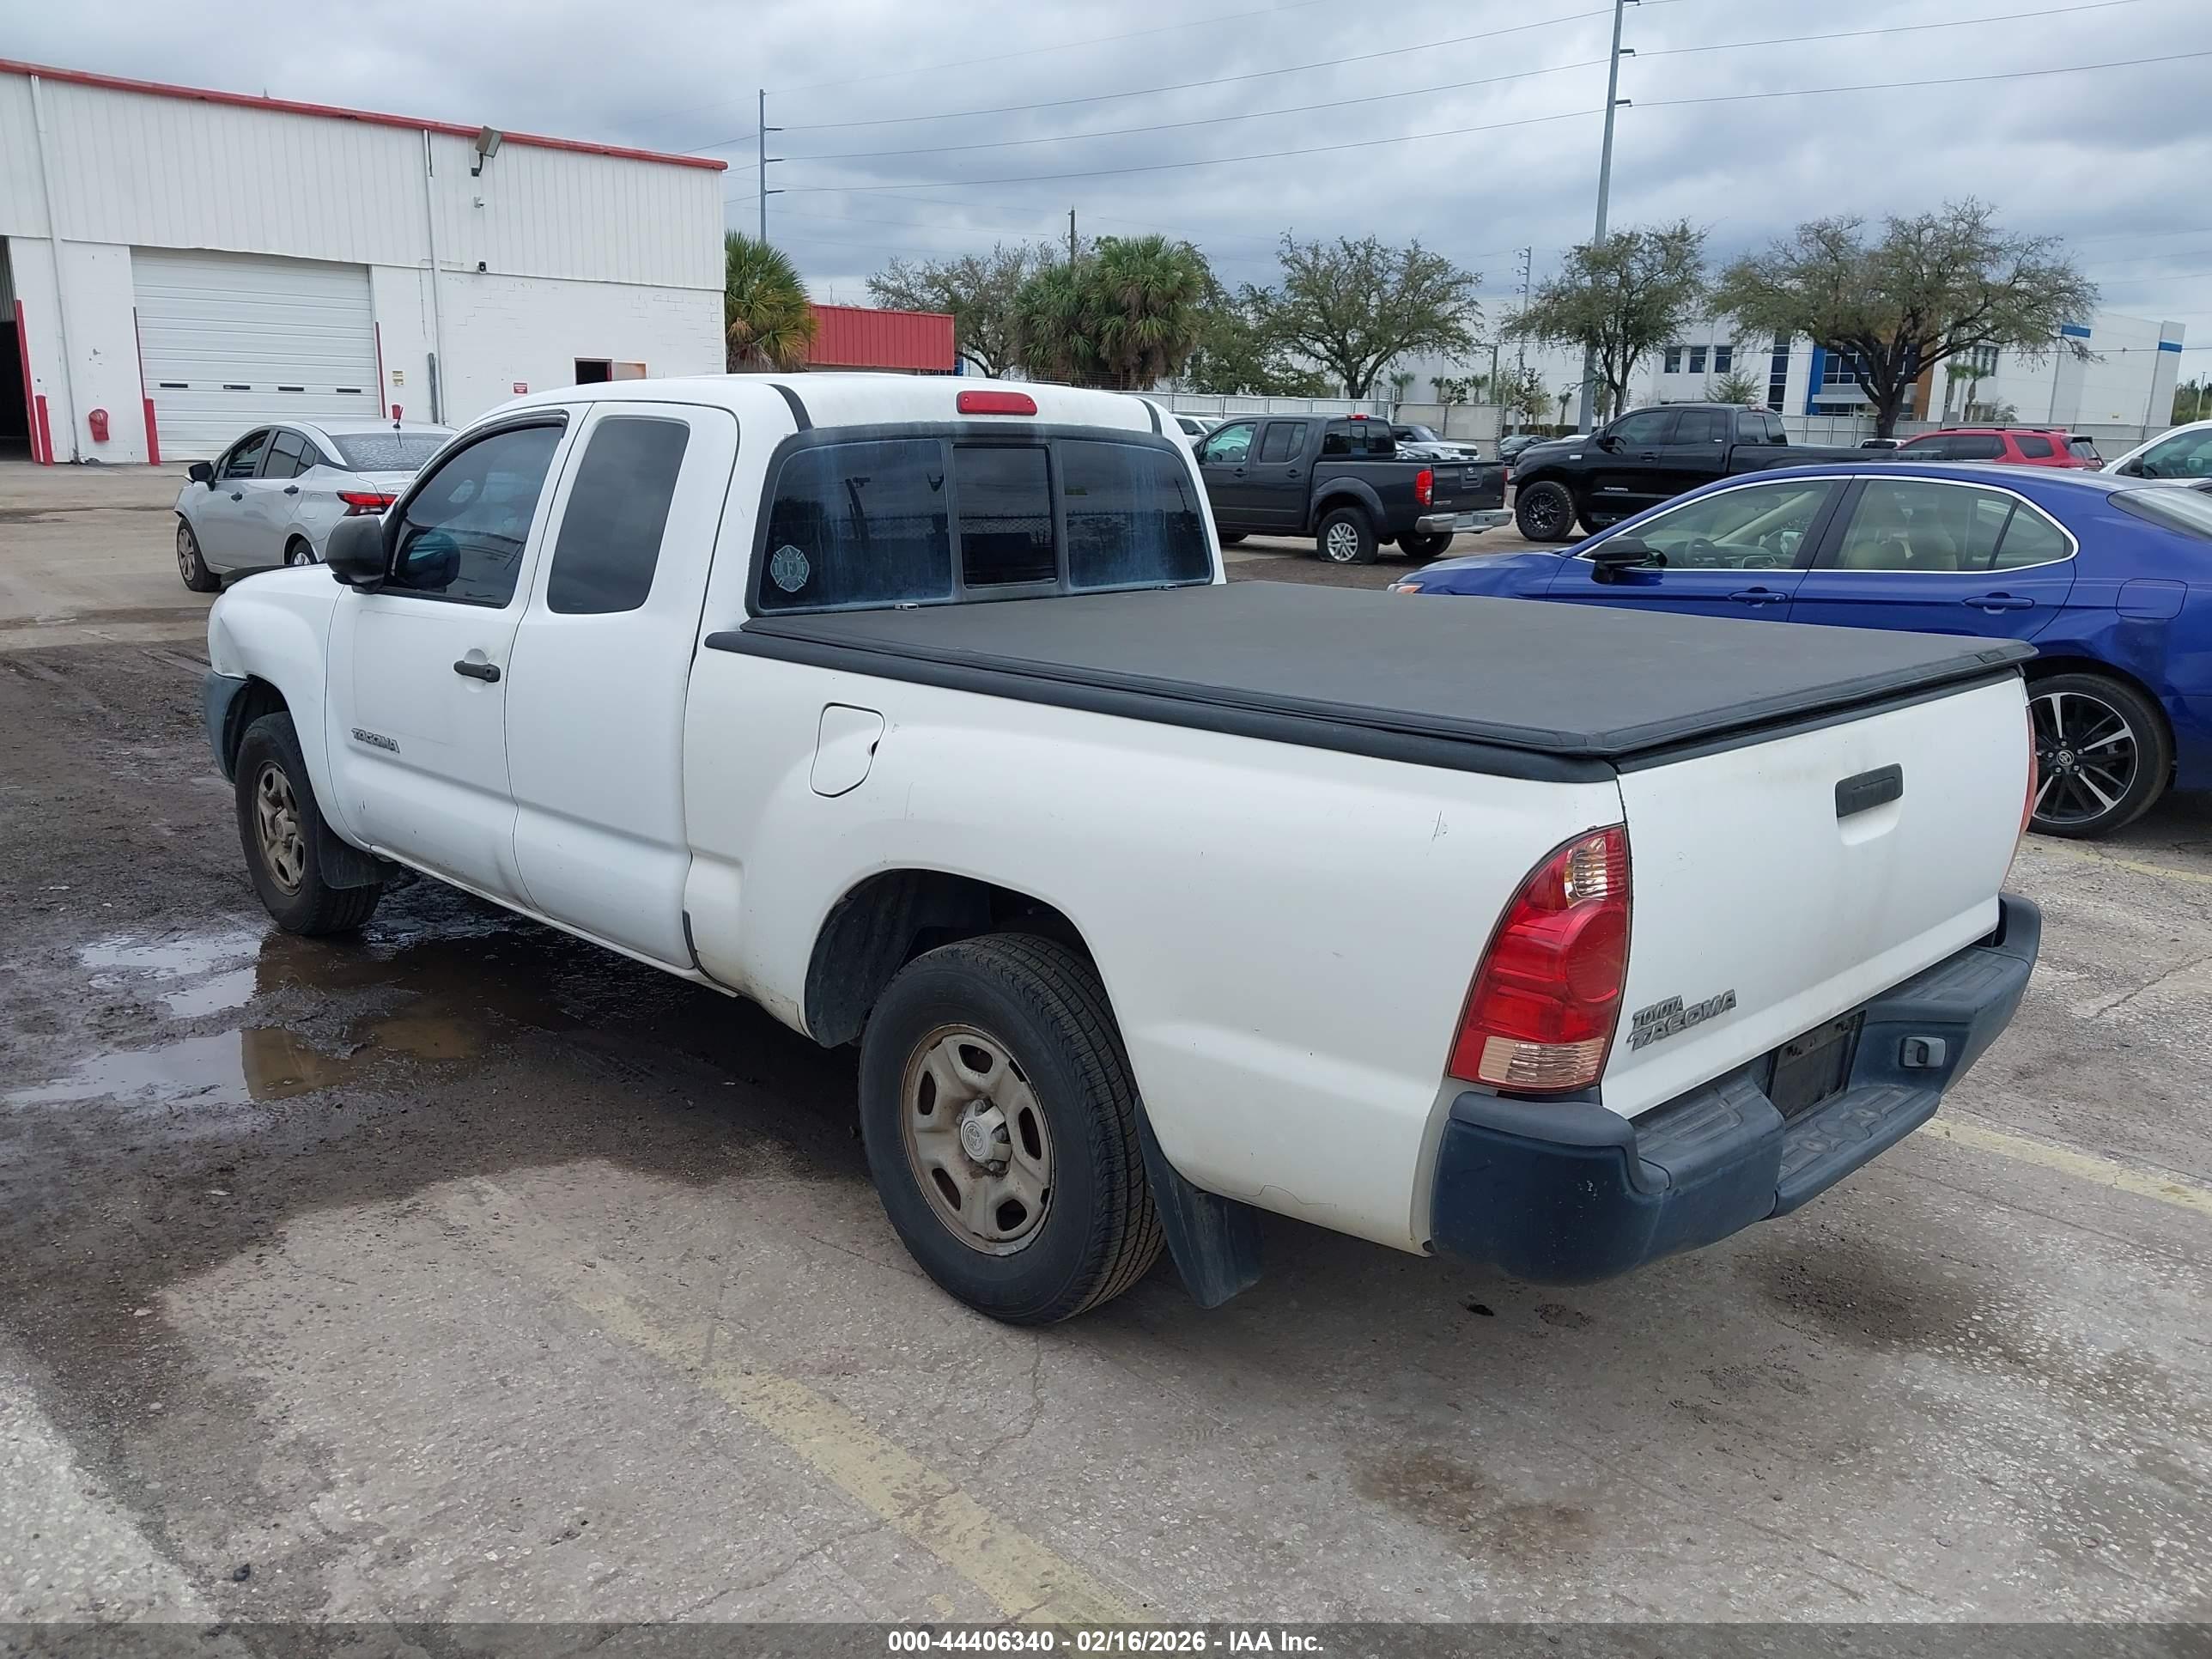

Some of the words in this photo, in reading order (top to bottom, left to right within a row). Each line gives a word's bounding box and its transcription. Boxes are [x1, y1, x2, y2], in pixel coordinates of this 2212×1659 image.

[350, 727, 400, 754] TACOMA
[1626, 988, 1737, 1052] TACOMA
[1632, 994, 1684, 1030] TOYOTA
